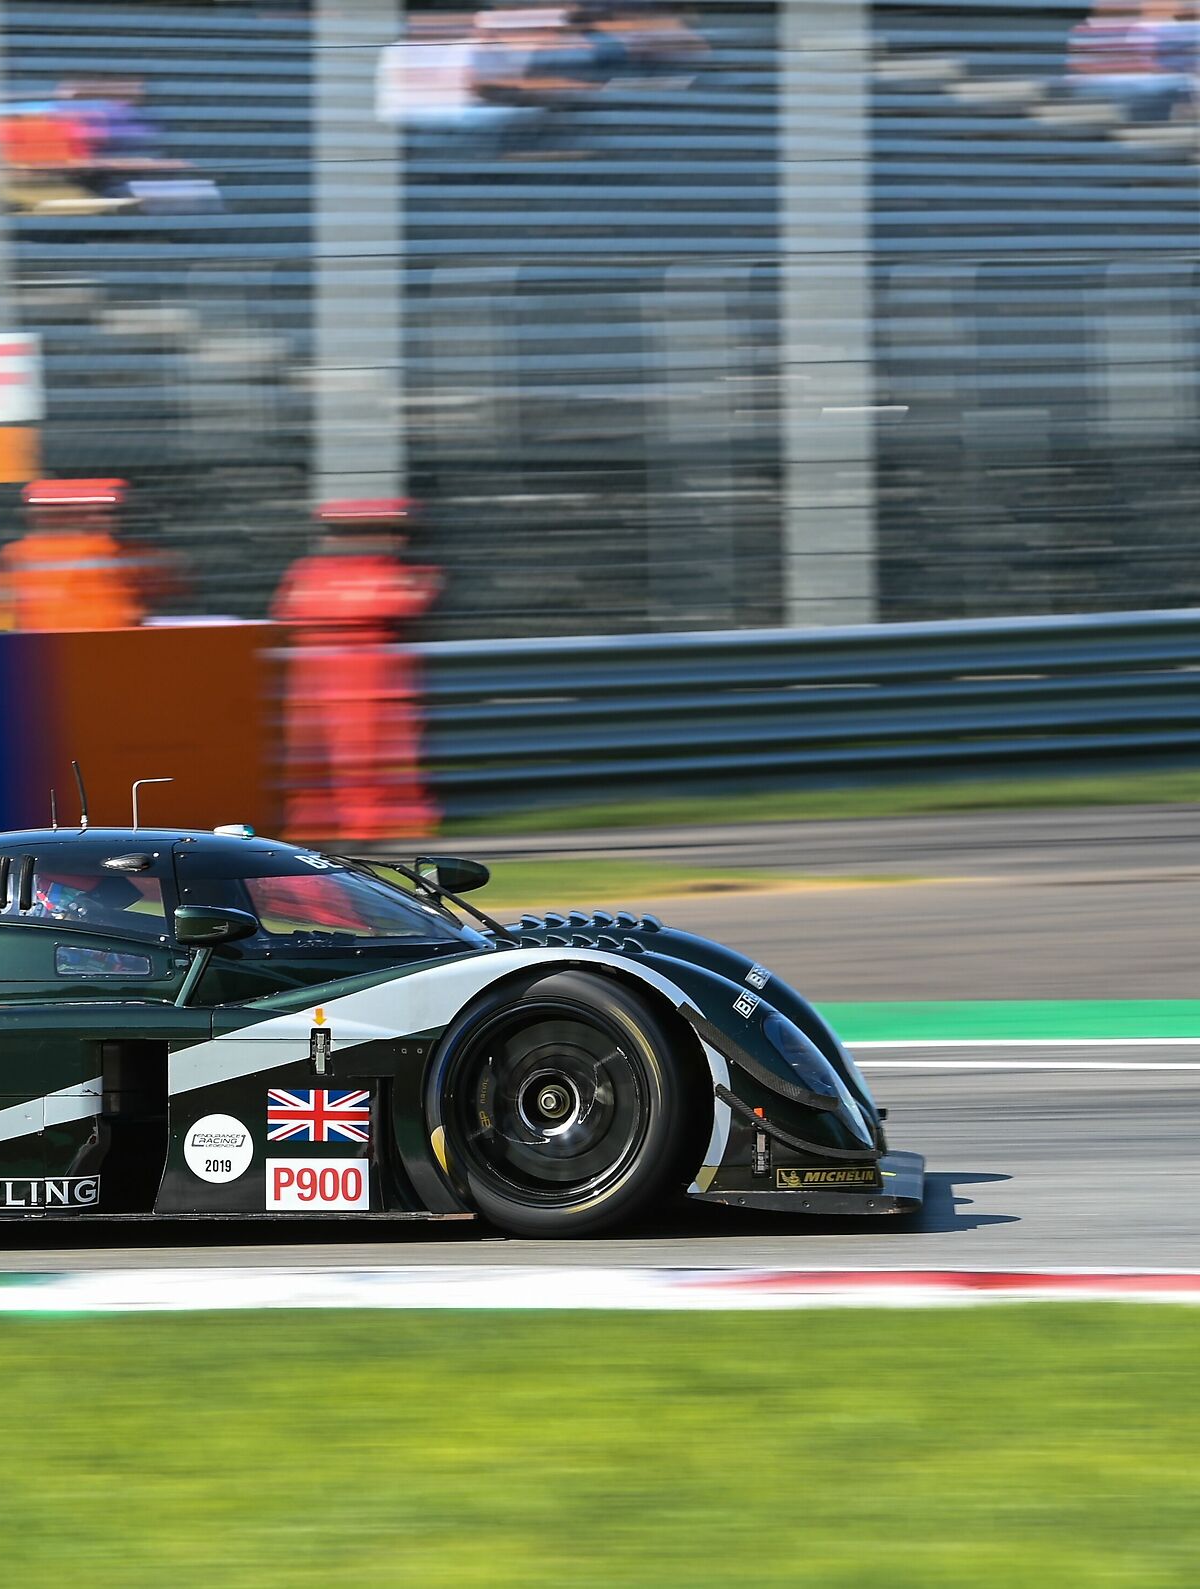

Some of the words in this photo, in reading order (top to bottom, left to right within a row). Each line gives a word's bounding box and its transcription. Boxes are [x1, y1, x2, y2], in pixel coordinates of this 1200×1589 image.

[205, 1159, 232, 1172] 2019
[803, 1171, 875, 1182] MICHELIN
[273, 1167, 363, 1201] P900
